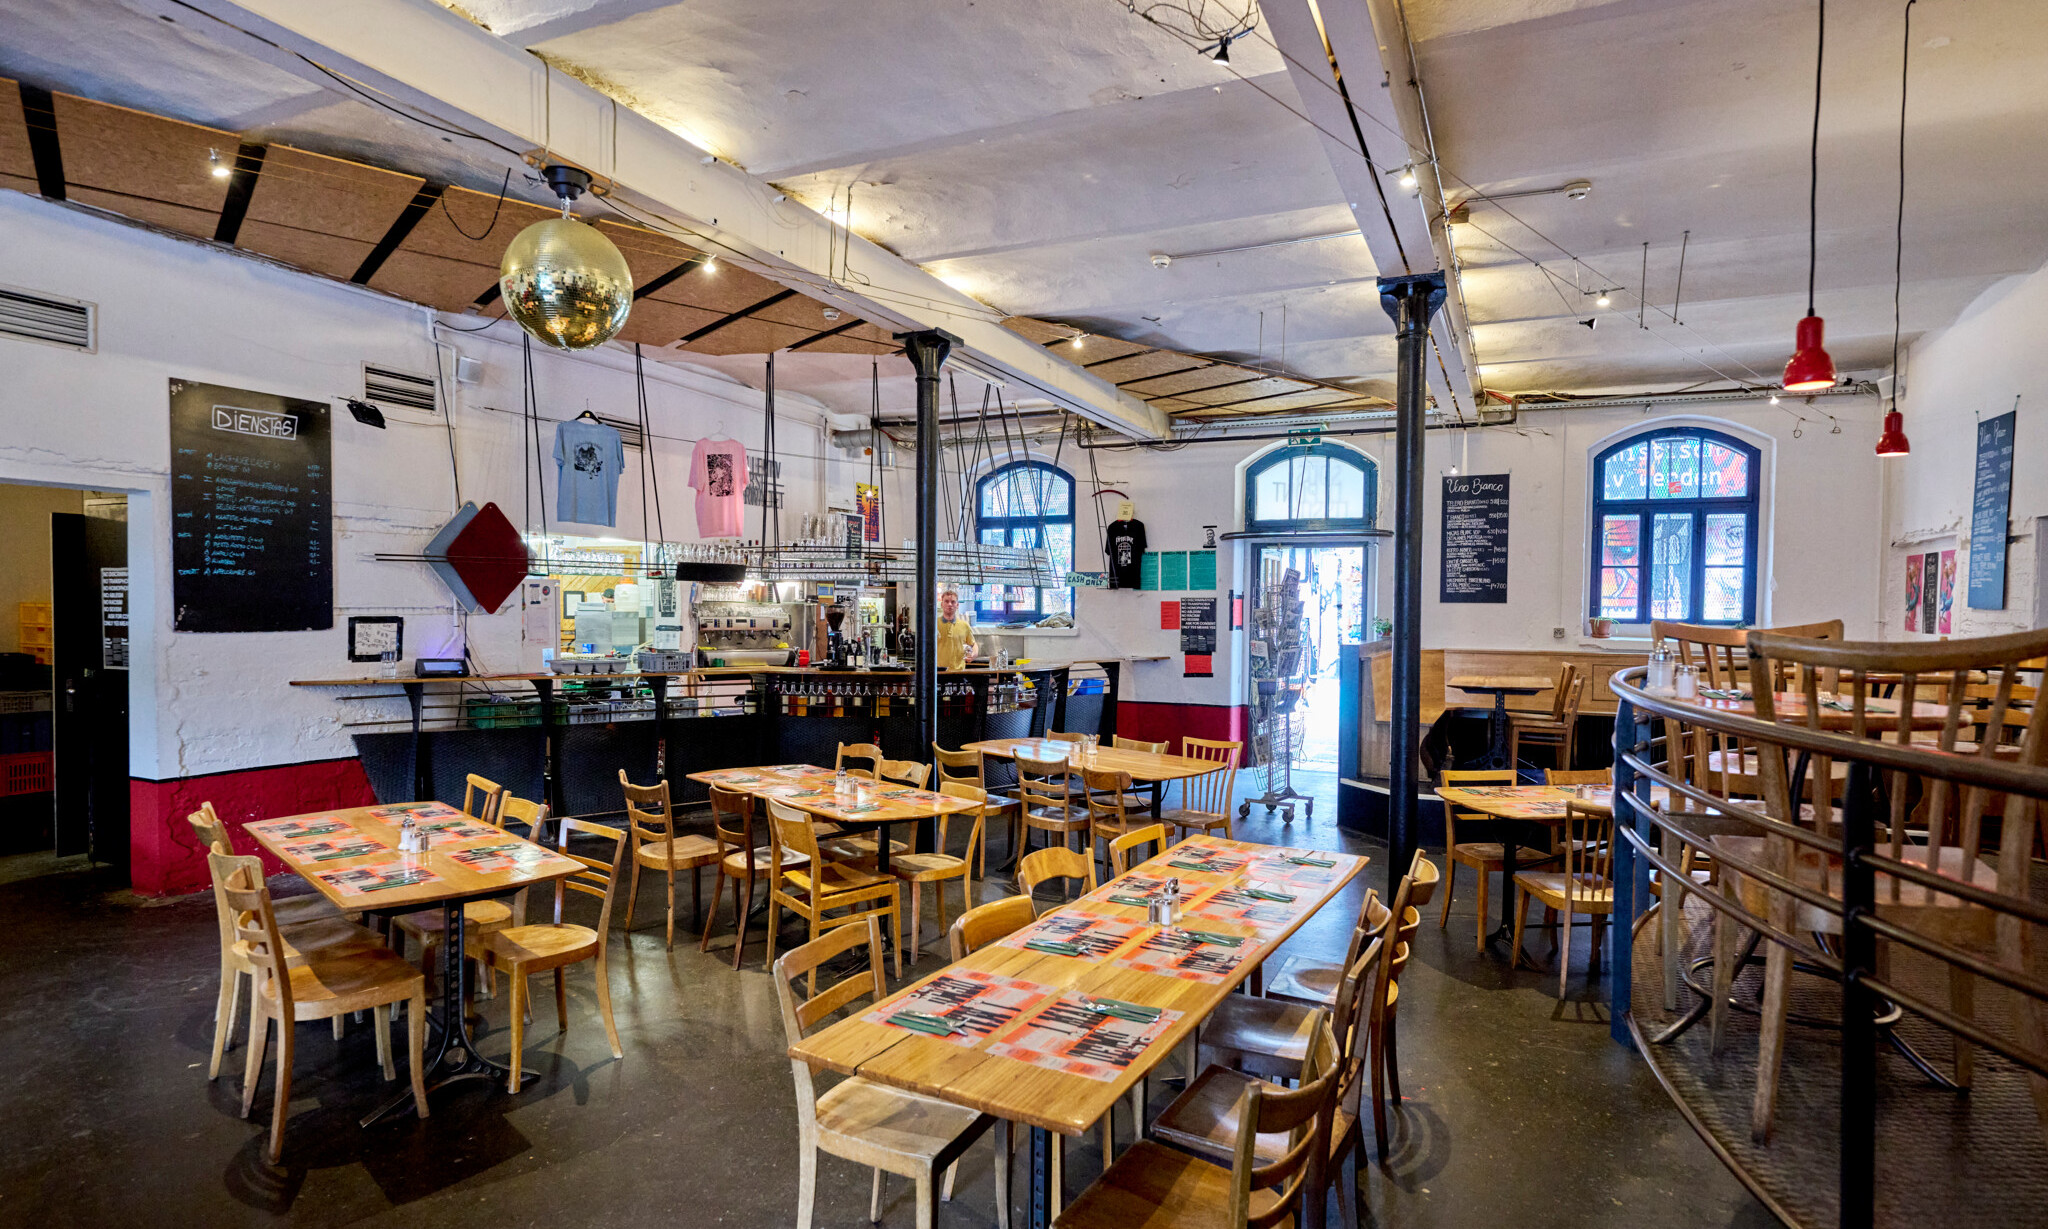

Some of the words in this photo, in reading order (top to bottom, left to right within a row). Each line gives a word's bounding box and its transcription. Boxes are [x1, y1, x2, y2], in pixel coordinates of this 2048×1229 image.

[216, 410, 293, 436] DIENSTAG
[1446, 478, 1470, 494] Vino
[1471, 478, 1504, 495] Bianco
